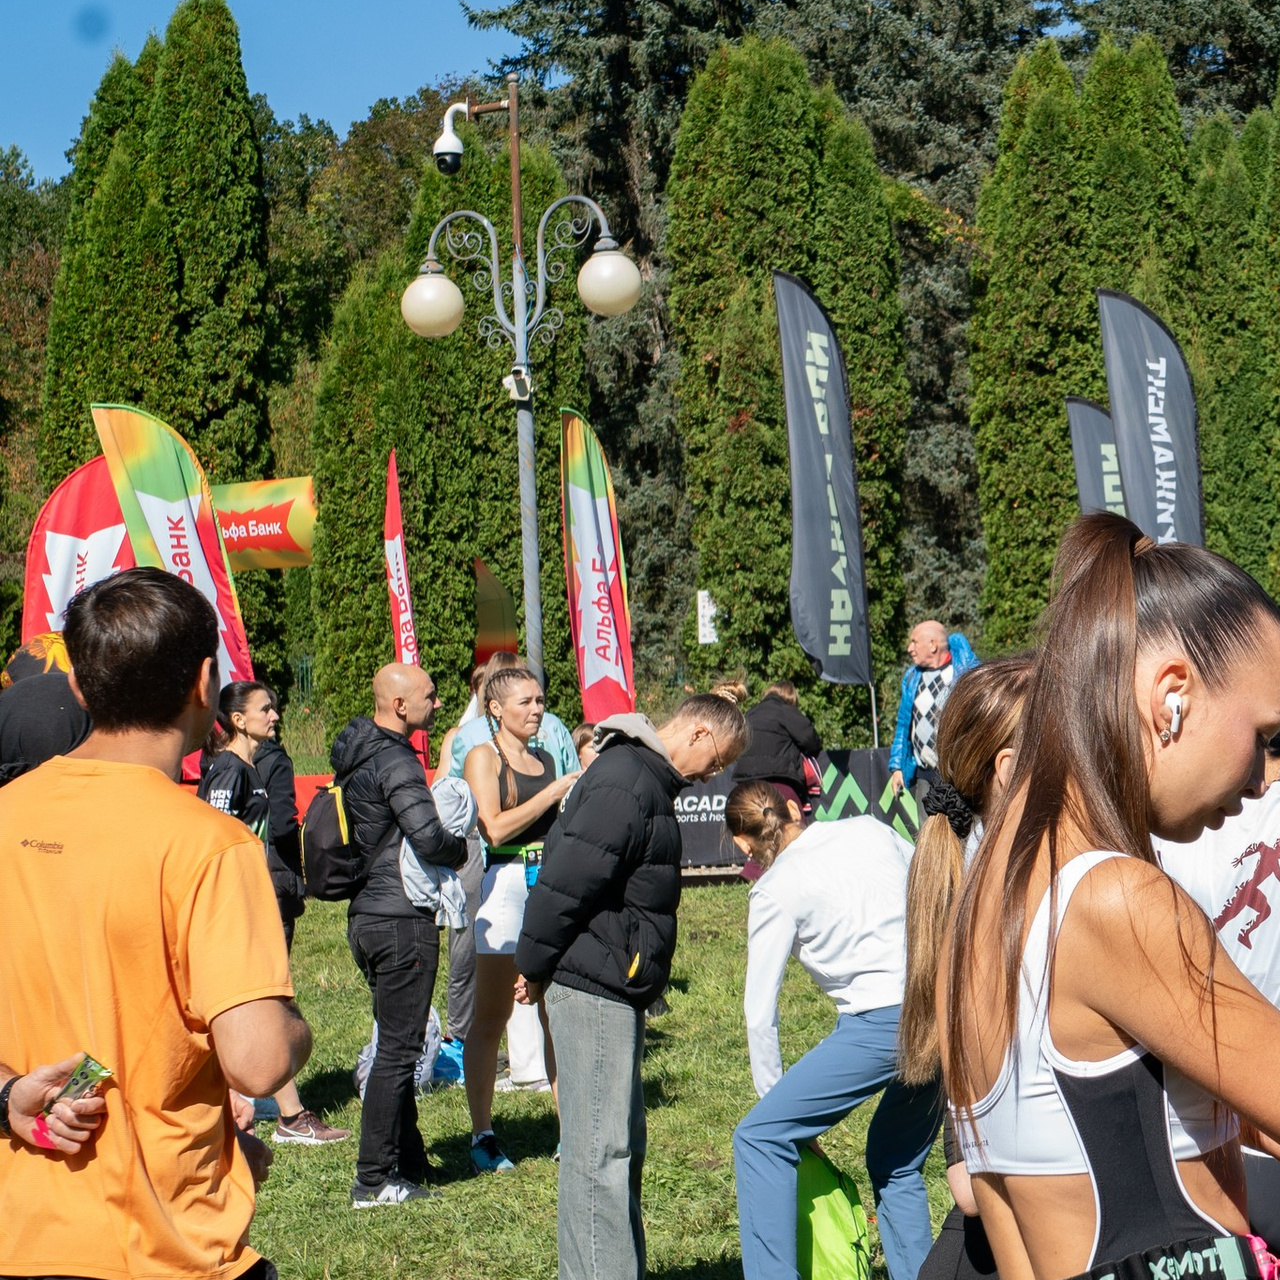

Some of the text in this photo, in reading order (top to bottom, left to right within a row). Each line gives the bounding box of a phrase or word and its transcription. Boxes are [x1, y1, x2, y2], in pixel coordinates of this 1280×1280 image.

[221, 520, 283, 542] ьфа Банк
[674, 812, 699, 823] ports
